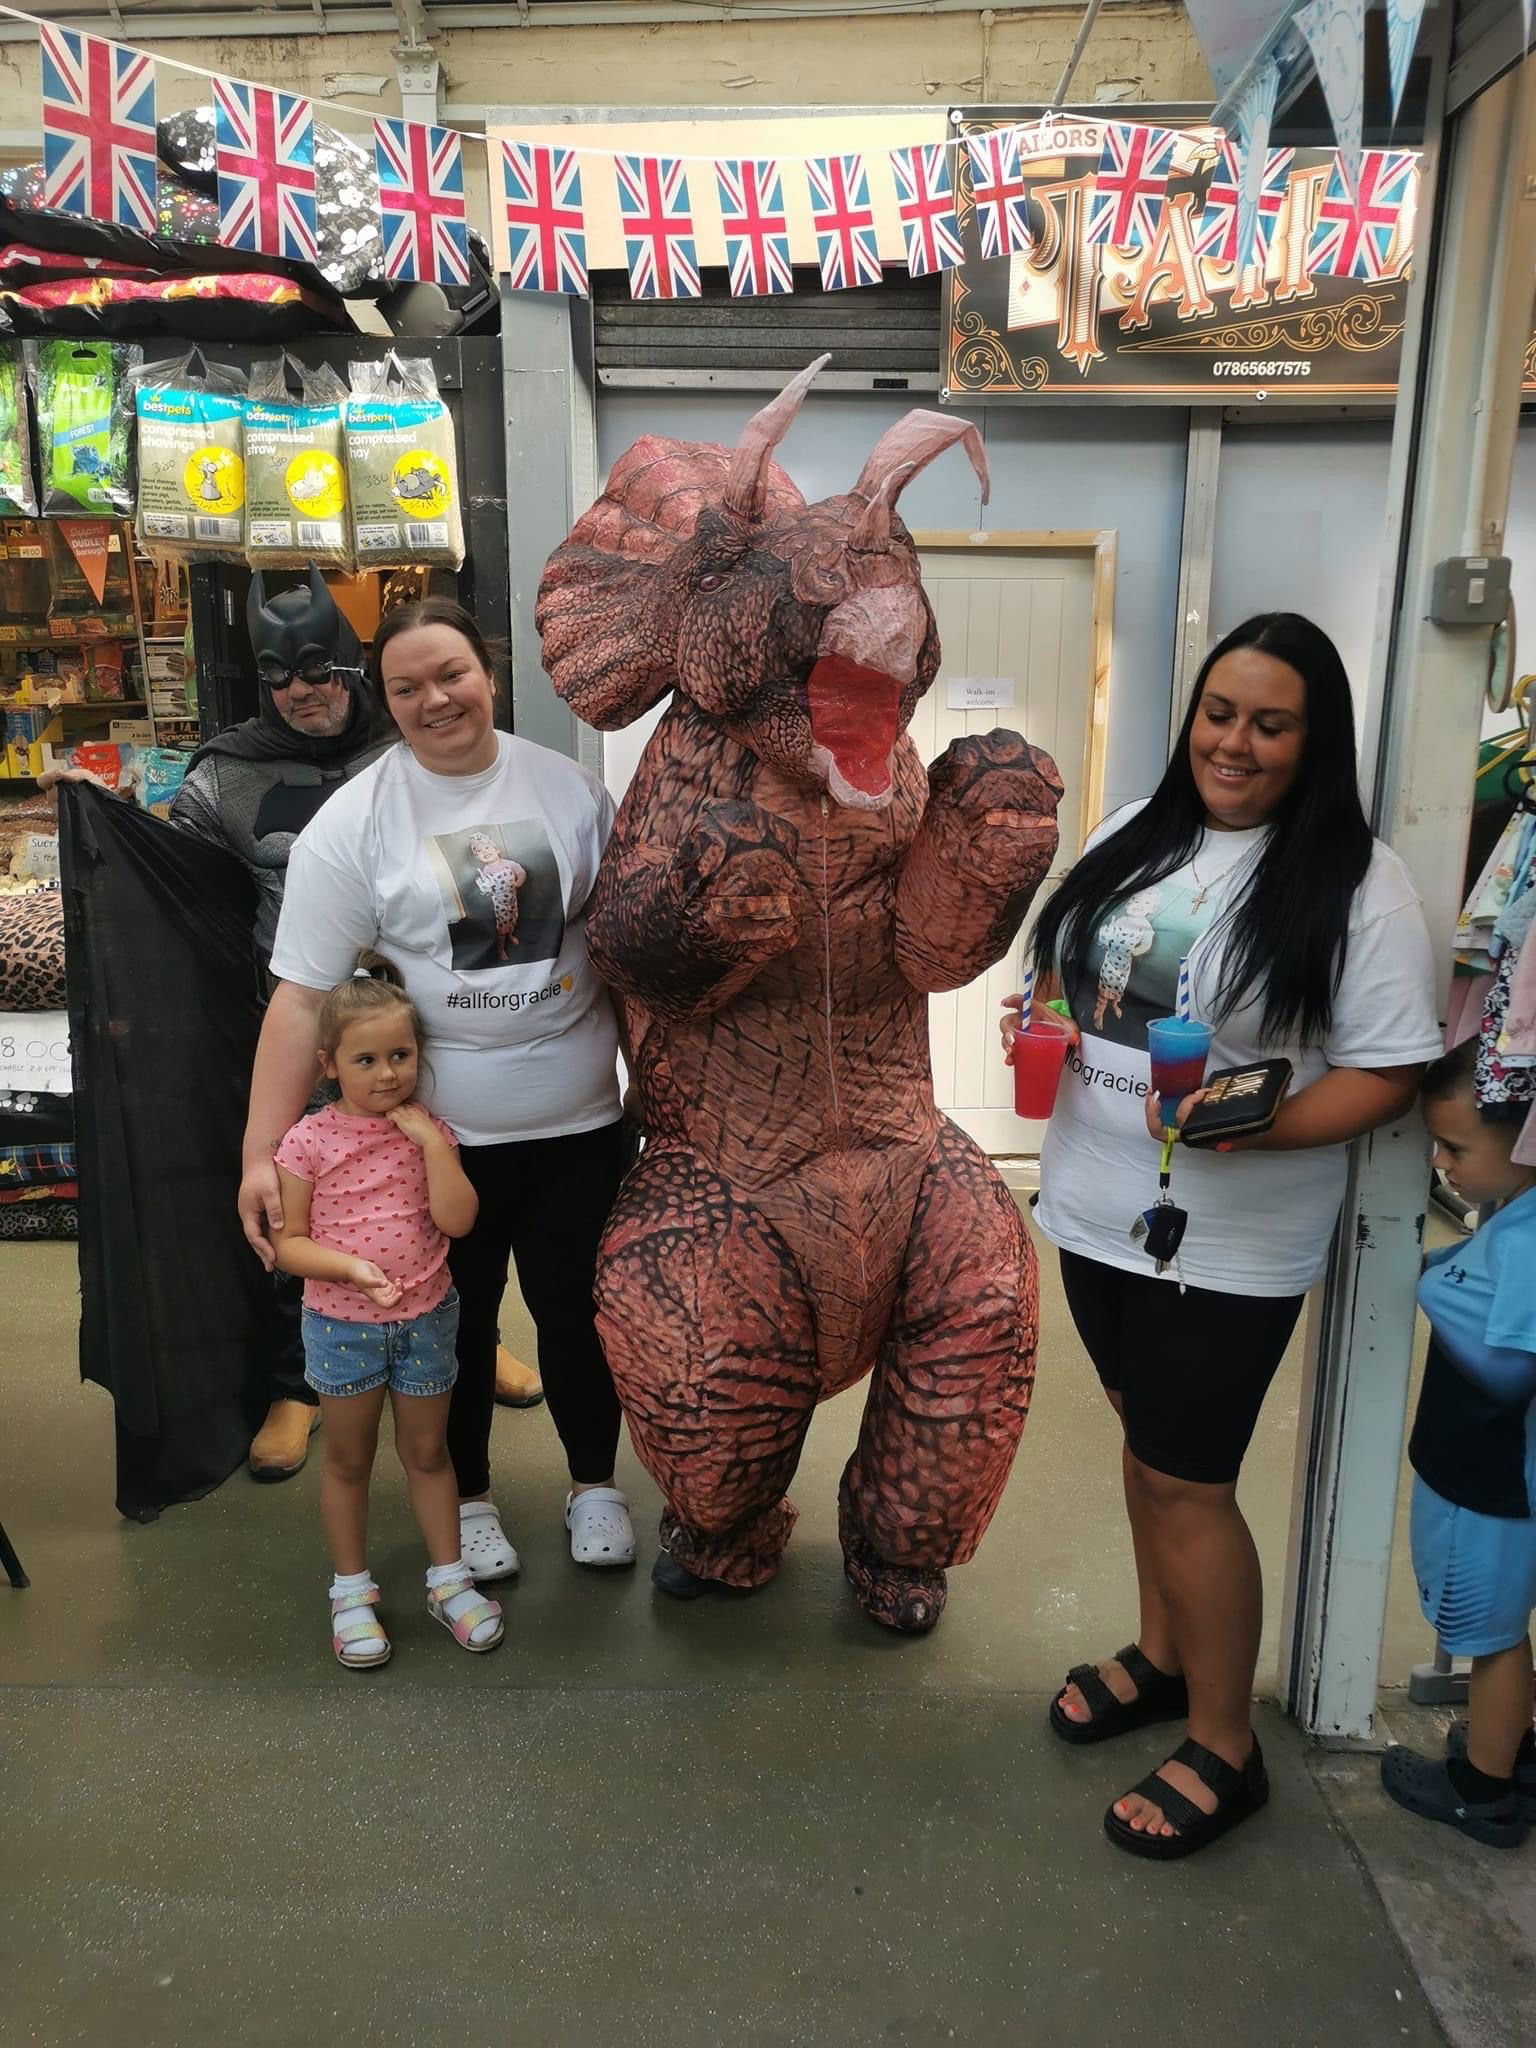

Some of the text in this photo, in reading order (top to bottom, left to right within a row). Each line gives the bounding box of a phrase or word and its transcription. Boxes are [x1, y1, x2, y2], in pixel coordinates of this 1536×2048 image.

[1019, 127, 1098, 156] AILORS
[1212, 360, 1312, 376] 07865687575
[141, 424, 215, 441] compressed
[247, 432, 314, 446] compressed
[349, 431, 417, 447] compressed
[141, 436, 196, 454] shavings
[247, 444, 277, 456] straw
[350, 447, 370, 461] hay
[966, 688, 996, 696] Walk-ins
[966, 698, 995, 706] welcome
[447, 982, 562, 1011] #allforgracie
